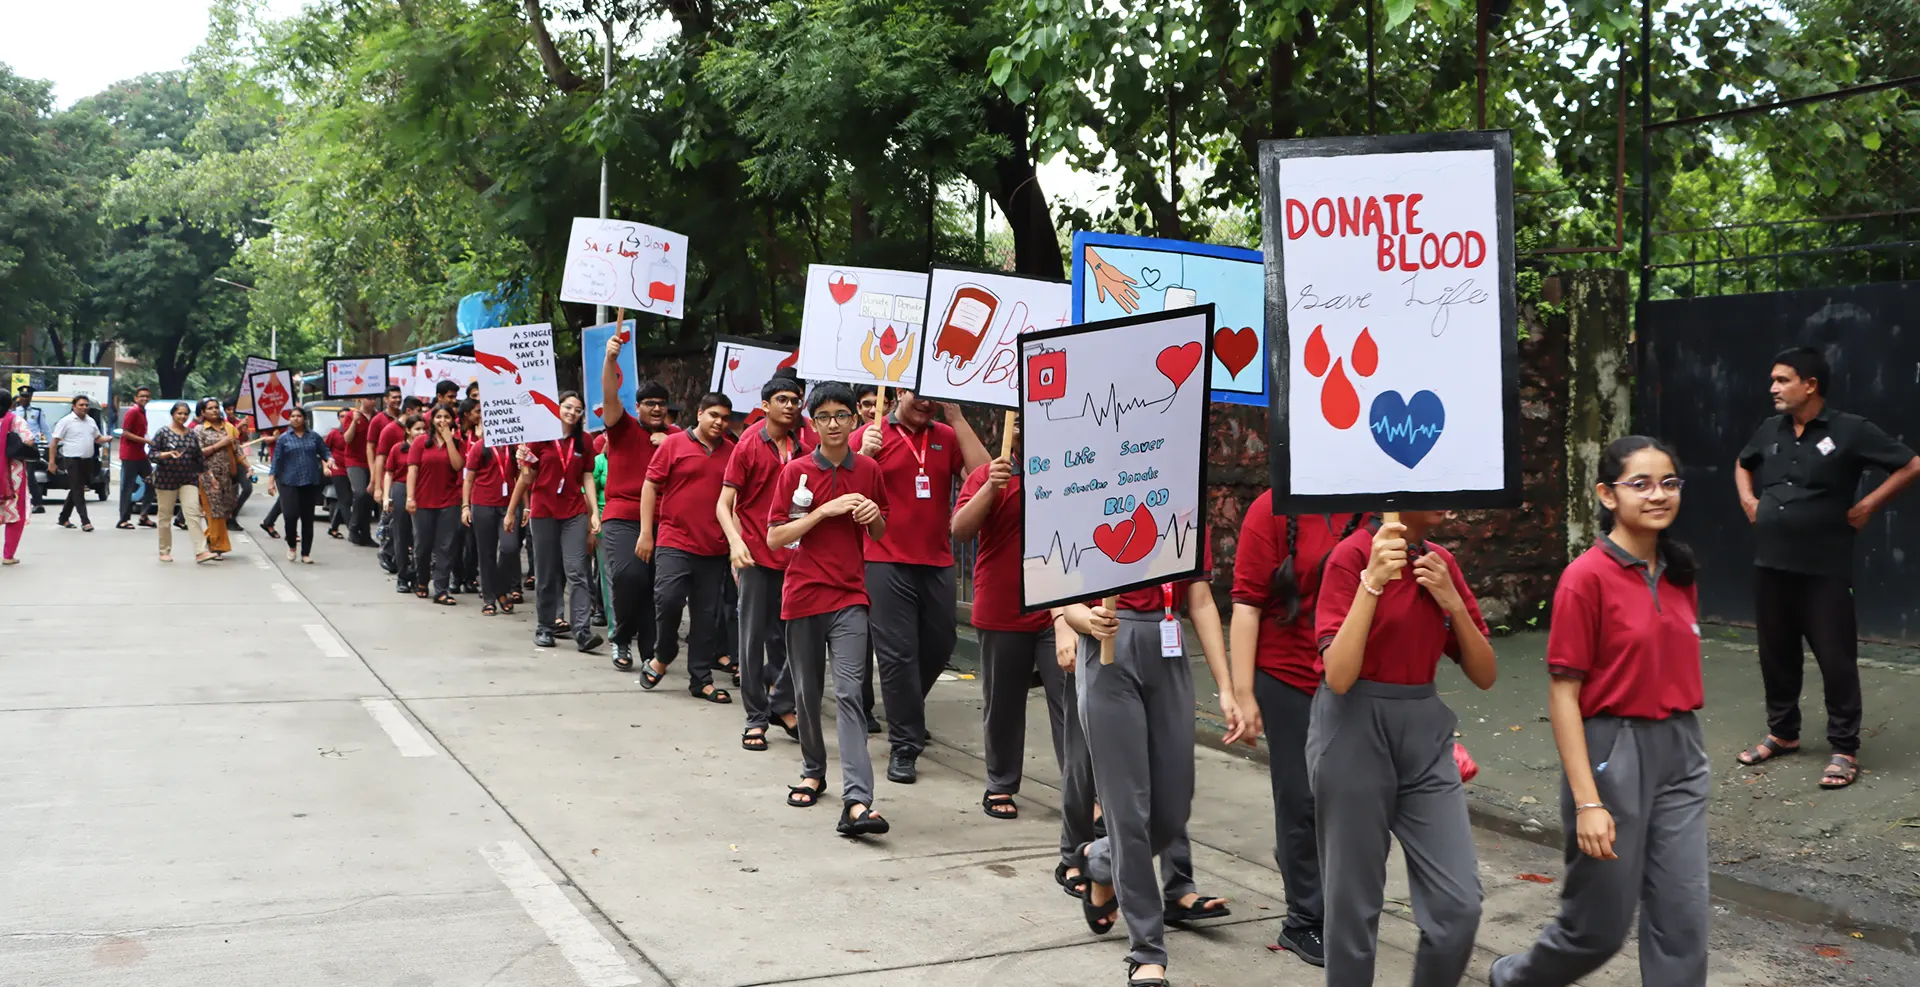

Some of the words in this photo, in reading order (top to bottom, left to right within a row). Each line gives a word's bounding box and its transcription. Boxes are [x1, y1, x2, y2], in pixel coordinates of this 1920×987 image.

[1285, 193, 1424, 240] DONATE
[1377, 230, 1486, 272] BLOOD
[513, 332, 520, 340] A
[522, 329, 552, 339] SINGLE
[509, 341, 530, 350] PRICK
[532, 340, 549, 348] CAN
[516, 350, 534, 359] SAVE
[483, 400, 490, 408] A
[484, 408, 514, 417] FAVOUR
[483, 419, 499, 427] CAN
[501, 416, 521, 425] MAKE
[495, 425, 525, 435] MILLION
[1029, 456, 1051, 475] Be
[1064, 446, 1096, 468] Life
[1120, 438, 1165, 456] Saver
[1034, 486, 1053, 500] for
[1117, 466, 1159, 486] Donate
